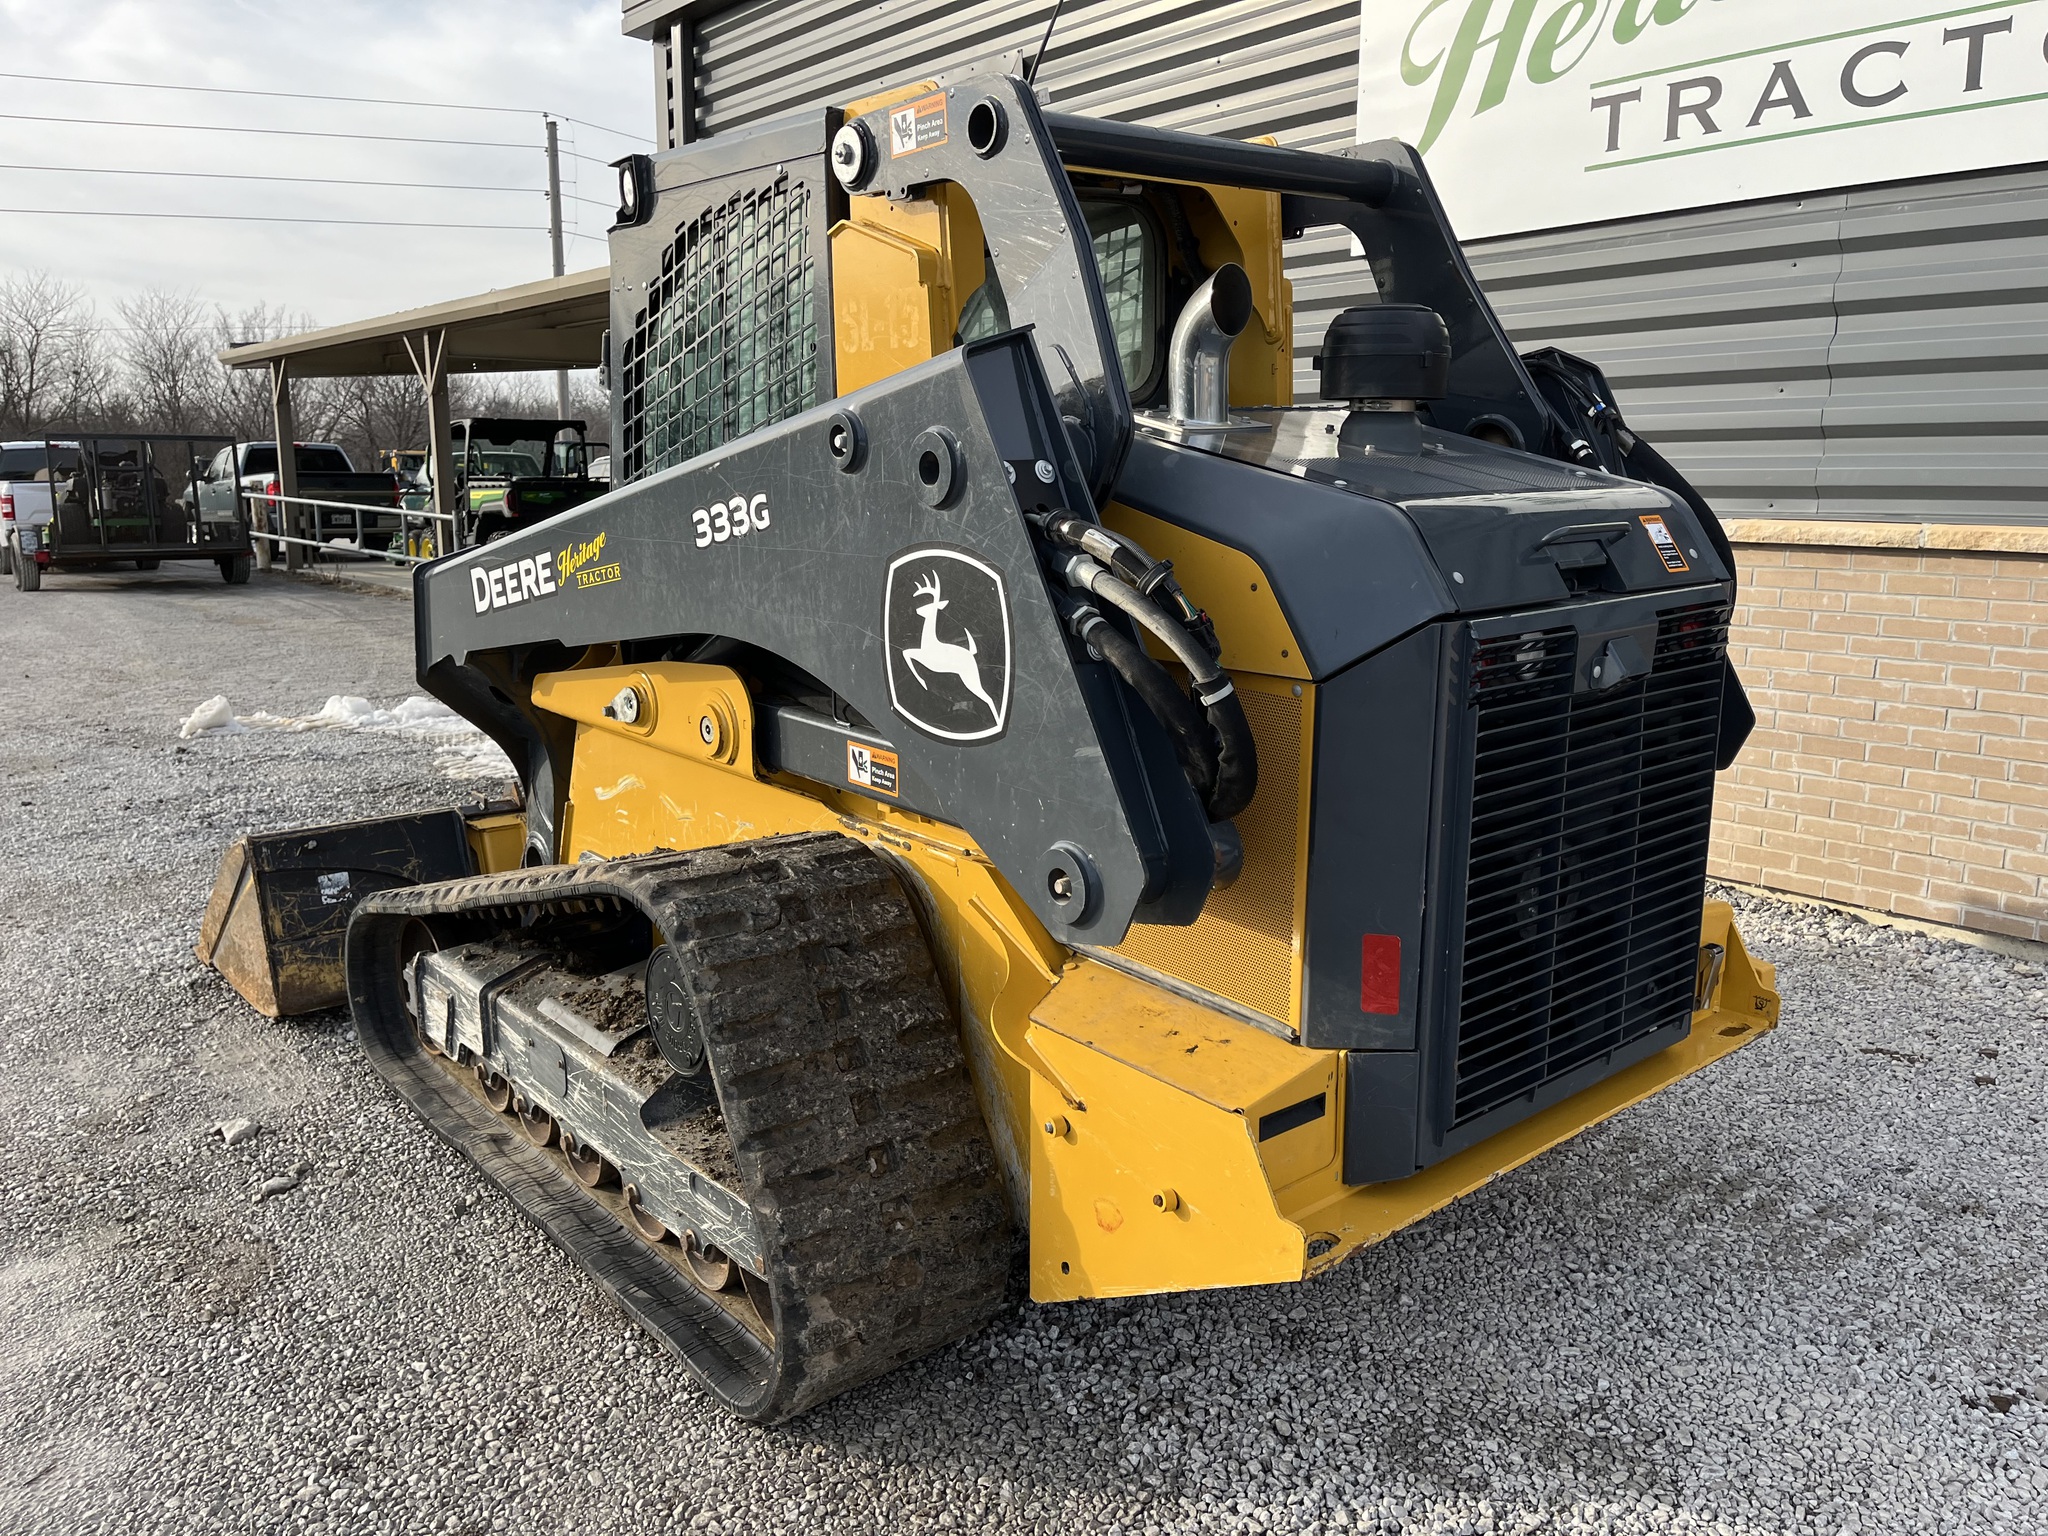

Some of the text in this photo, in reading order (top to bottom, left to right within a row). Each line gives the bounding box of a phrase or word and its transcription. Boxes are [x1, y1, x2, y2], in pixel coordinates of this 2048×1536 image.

[1590, 15, 2048, 153] TRACT
[916, 118, 943, 132] Pinch Area
[917, 130, 940, 142] Keep Away
[692, 493, 771, 548] 333G
[557, 531, 607, 587] Heritage
[470, 551, 556, 613] DEERE
[576, 565, 621, 586] TRACTOR
[871, 766, 896, 780] Pinch Area
[871, 775, 892, 787] Keep Away
